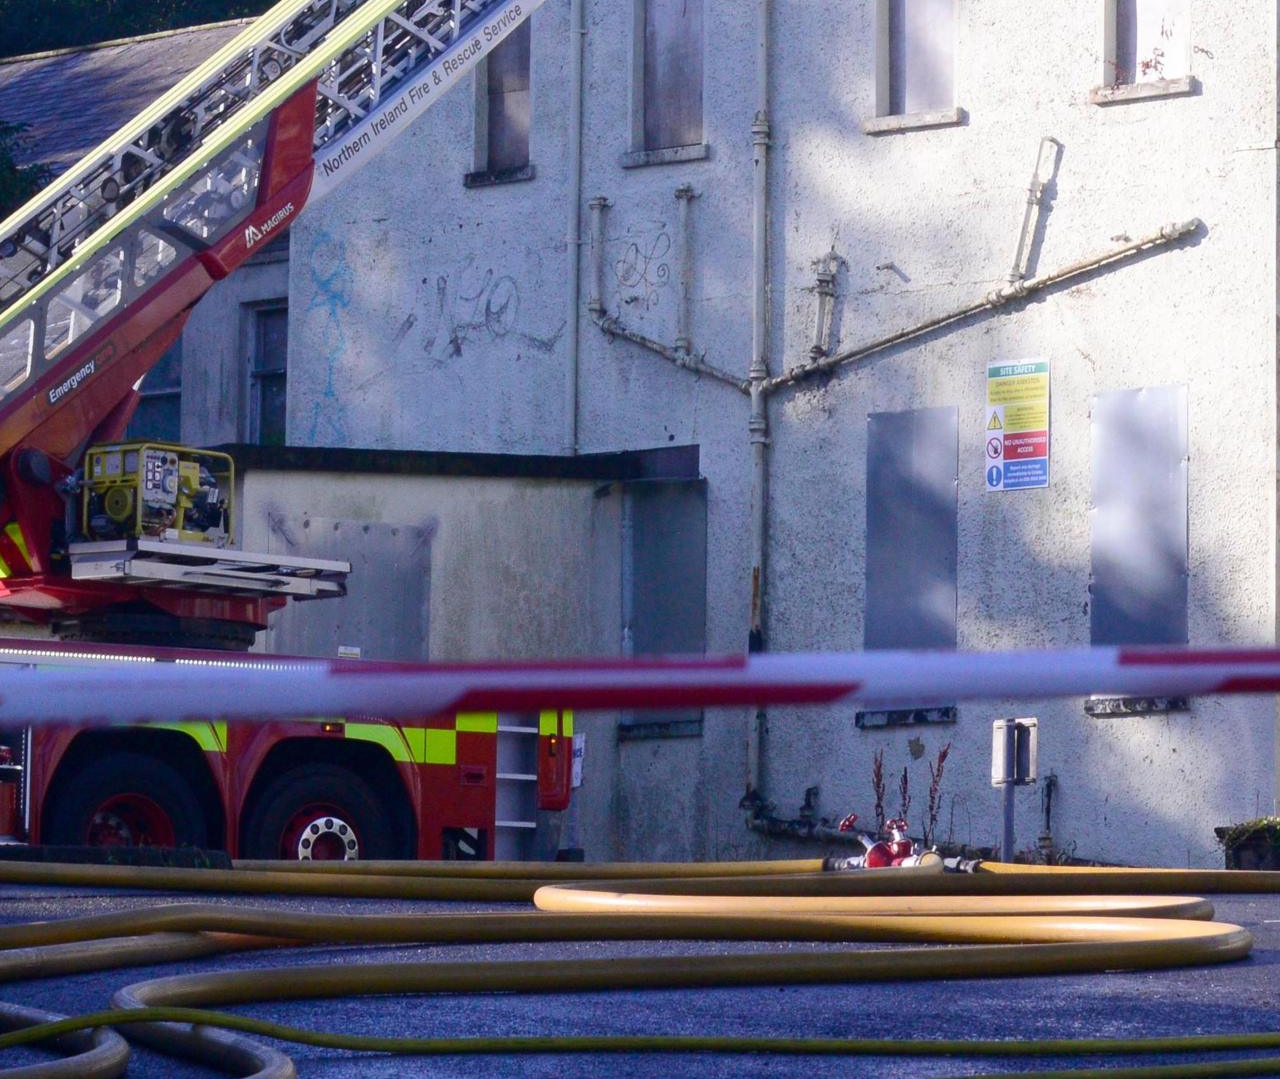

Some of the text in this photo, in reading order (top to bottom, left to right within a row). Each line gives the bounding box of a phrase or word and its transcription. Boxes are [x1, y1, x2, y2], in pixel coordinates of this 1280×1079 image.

[322, 2, 523, 177] Northern Ireland Fire & Rescue Service
[261, 202, 295, 235] MAGIRUS
[48, 359, 96, 405] Emergency
[1000, 364, 1036, 376] SITE SAFETY
